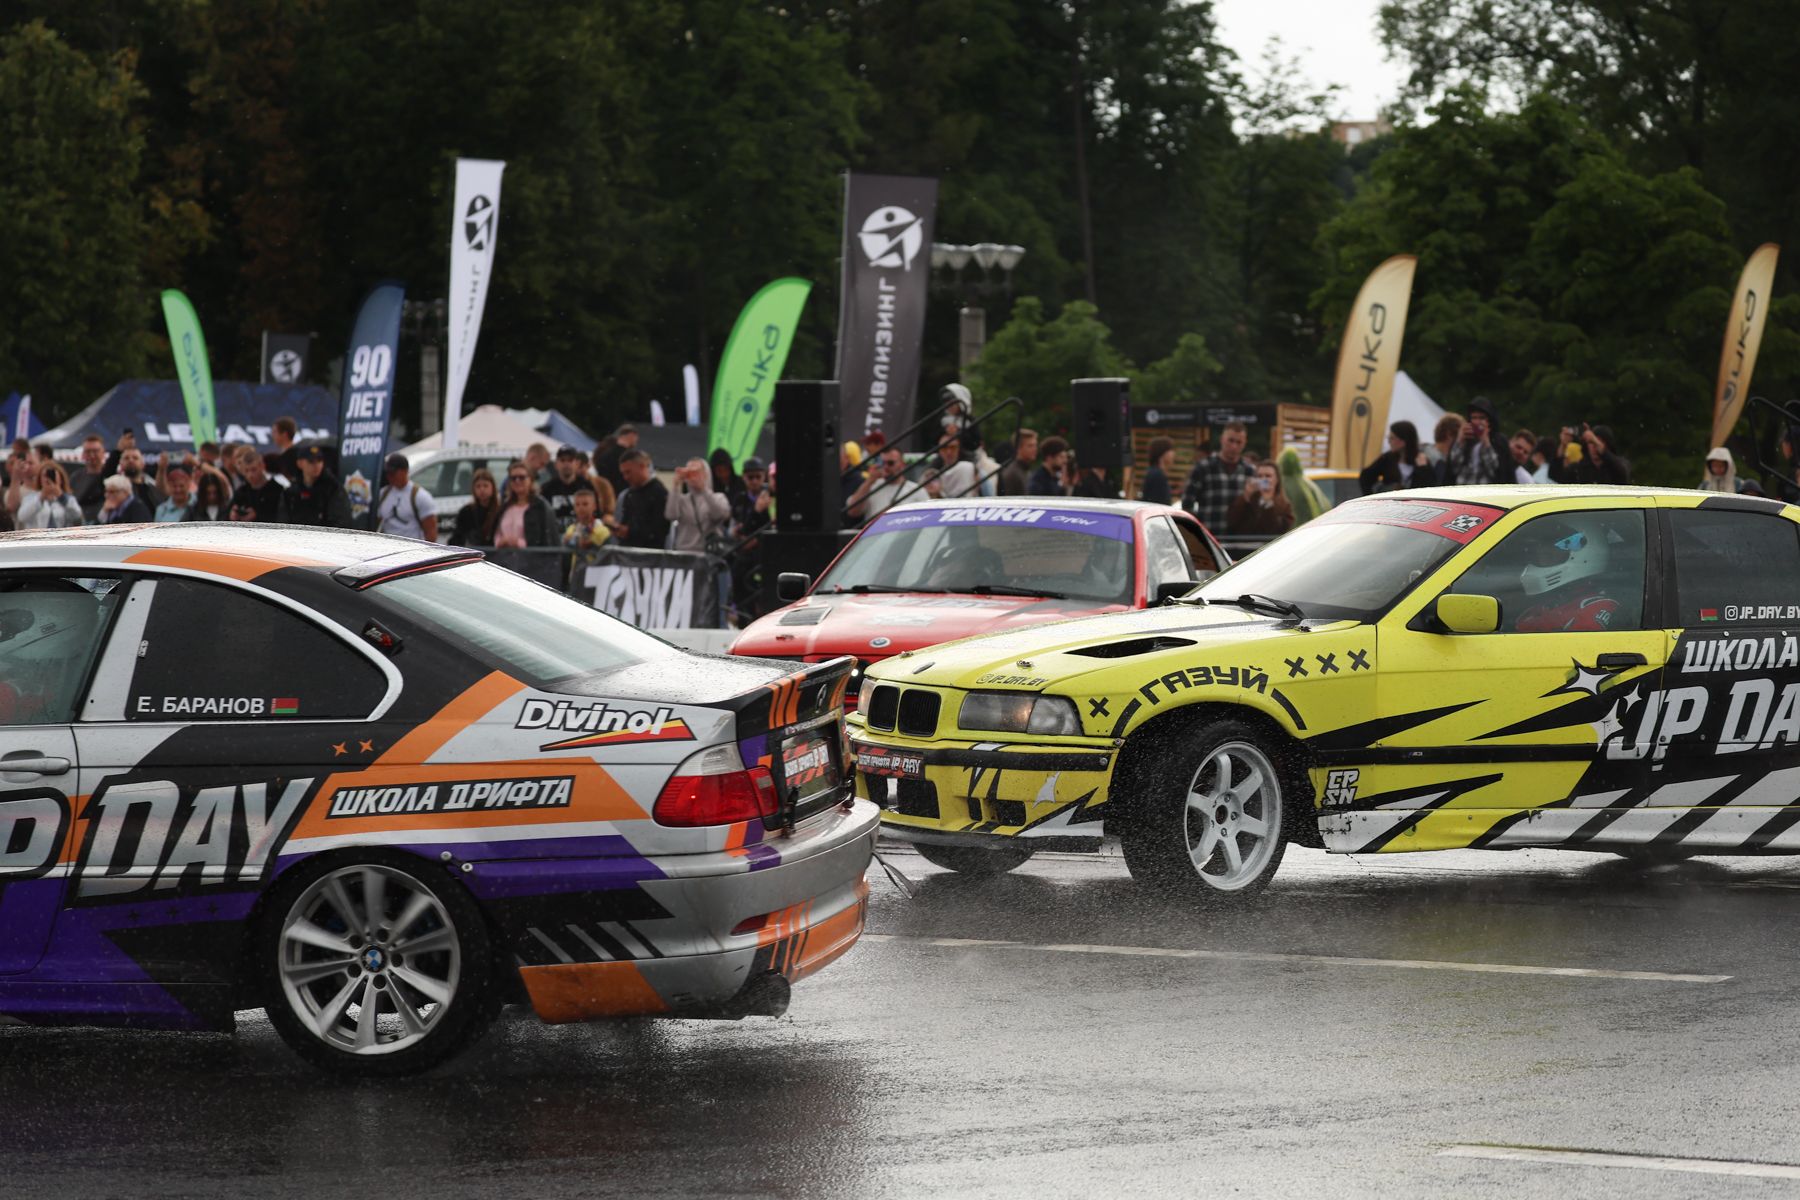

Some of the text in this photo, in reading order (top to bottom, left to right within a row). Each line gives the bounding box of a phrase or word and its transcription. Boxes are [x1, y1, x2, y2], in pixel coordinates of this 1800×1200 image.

[350, 344, 391, 388] 90
[346, 391, 387, 418] ЛЕТ
[144, 422, 330, 445] LEATN
[342, 436, 382, 456] СТРОЮ
[938, 507, 1047, 523] ТАЧКИ
[583, 564, 694, 632] ТАЧКИ
[1681, 636, 1799, 673] ШКОЛА
[1138, 665, 1269, 706] ГАЗУЙ
[137, 696, 265, 715] Е. БАРАНОВ
[515, 698, 673, 736] Divinol
[1606, 685, 1709, 772] JP
[330, 778, 573, 816] ШКОЛА ДРИФТА
[77, 777, 315, 898] DAY
